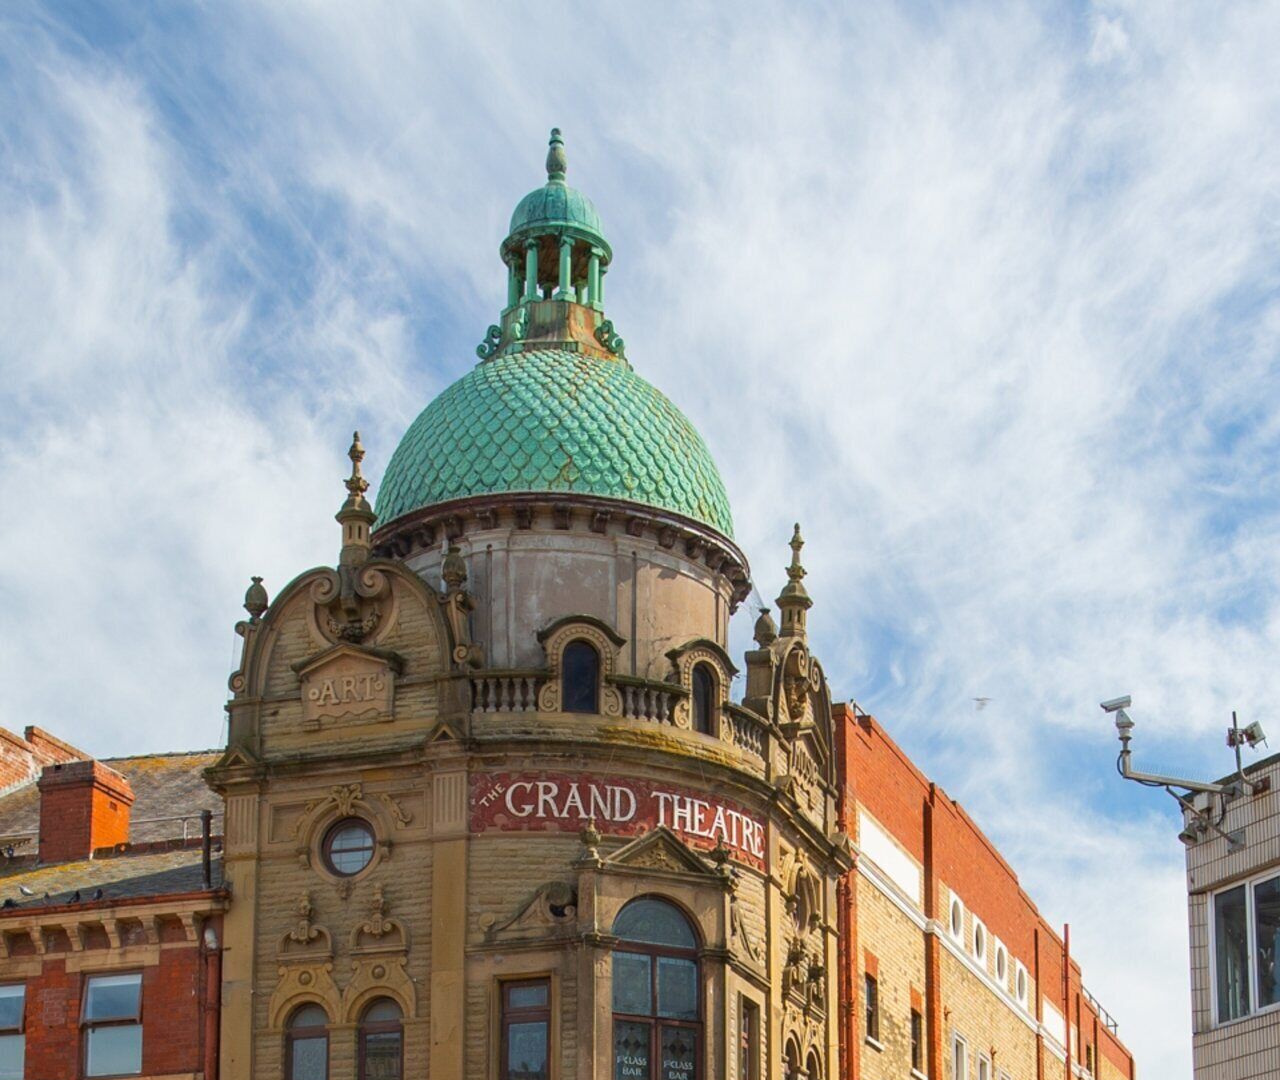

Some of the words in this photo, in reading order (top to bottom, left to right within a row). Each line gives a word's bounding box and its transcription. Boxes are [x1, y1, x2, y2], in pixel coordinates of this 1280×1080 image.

[316, 674, 377, 707] ART
[479, 782, 506, 808] THE
[505, 781, 637, 822] GRAND
[650, 790, 765, 859] THEATRE
